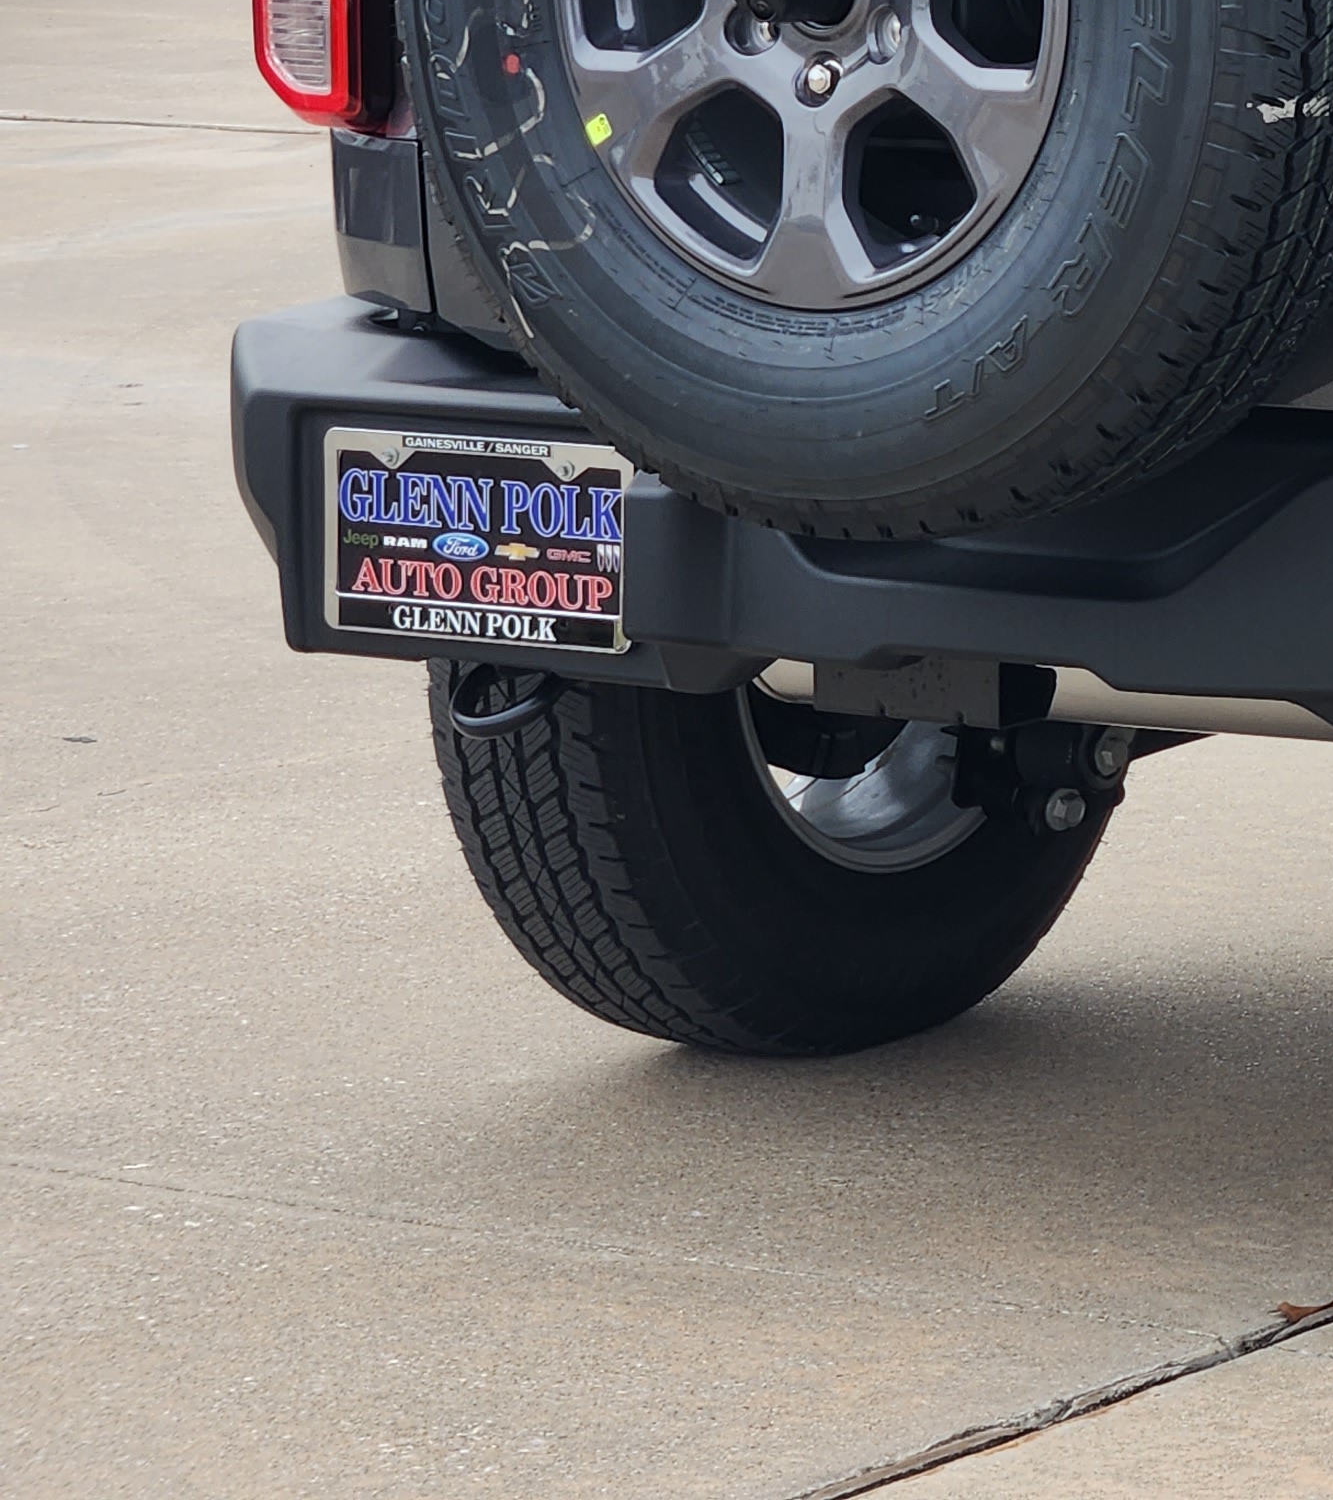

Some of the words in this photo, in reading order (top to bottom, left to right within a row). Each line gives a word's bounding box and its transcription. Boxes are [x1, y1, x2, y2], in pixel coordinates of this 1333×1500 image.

[925, 314, 1028, 423] A/T
[405, 436, 486, 452] GAINESVILLE
[495, 443, 549, 457] SANGER
[339, 467, 494, 532] GLENN
[500, 479, 622, 542] POLK
[343, 528, 379, 549] Jeep
[383, 535, 428, 549] RAM
[443, 536, 480, 557] Ford
[546, 548, 592, 564] GMC
[352, 557, 463, 600] AUTO
[470, 566, 613, 612] GROUP
[392, 605, 480, 636] GLENN
[487, 613, 557, 643] POLK
